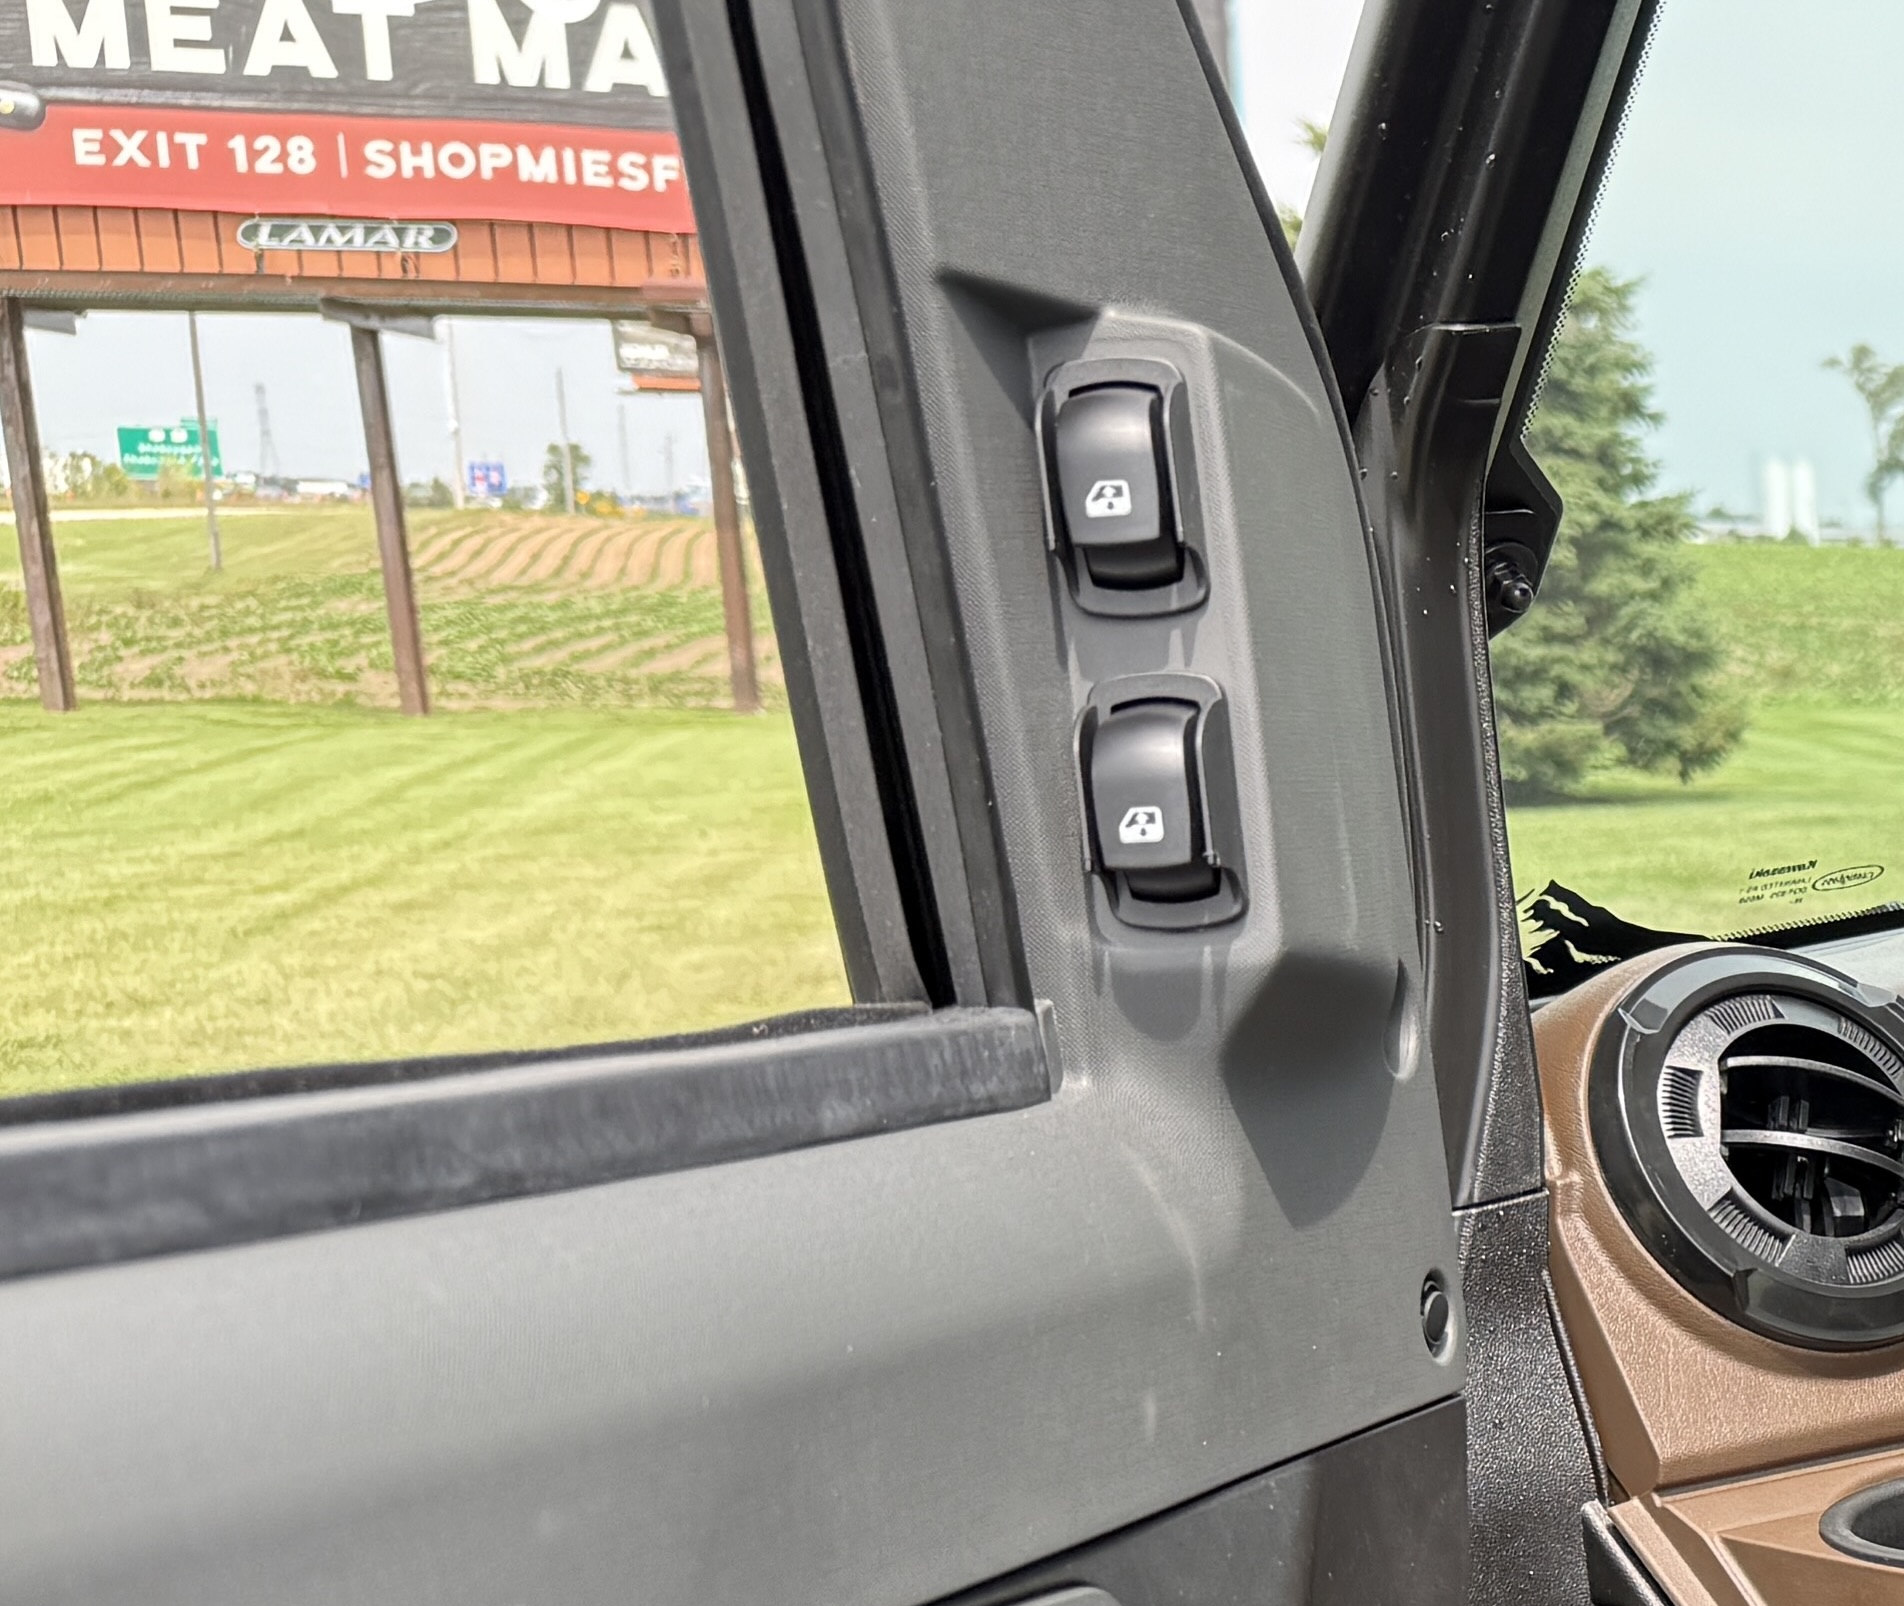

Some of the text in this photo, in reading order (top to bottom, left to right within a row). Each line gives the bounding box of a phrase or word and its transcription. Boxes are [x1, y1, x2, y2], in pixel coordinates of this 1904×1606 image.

[26, 0, 672, 98] MEAT MA
[71, 127, 684, 194] EXIT 128 SHOPMIESF
[255, 222, 437, 250] LAMAR
